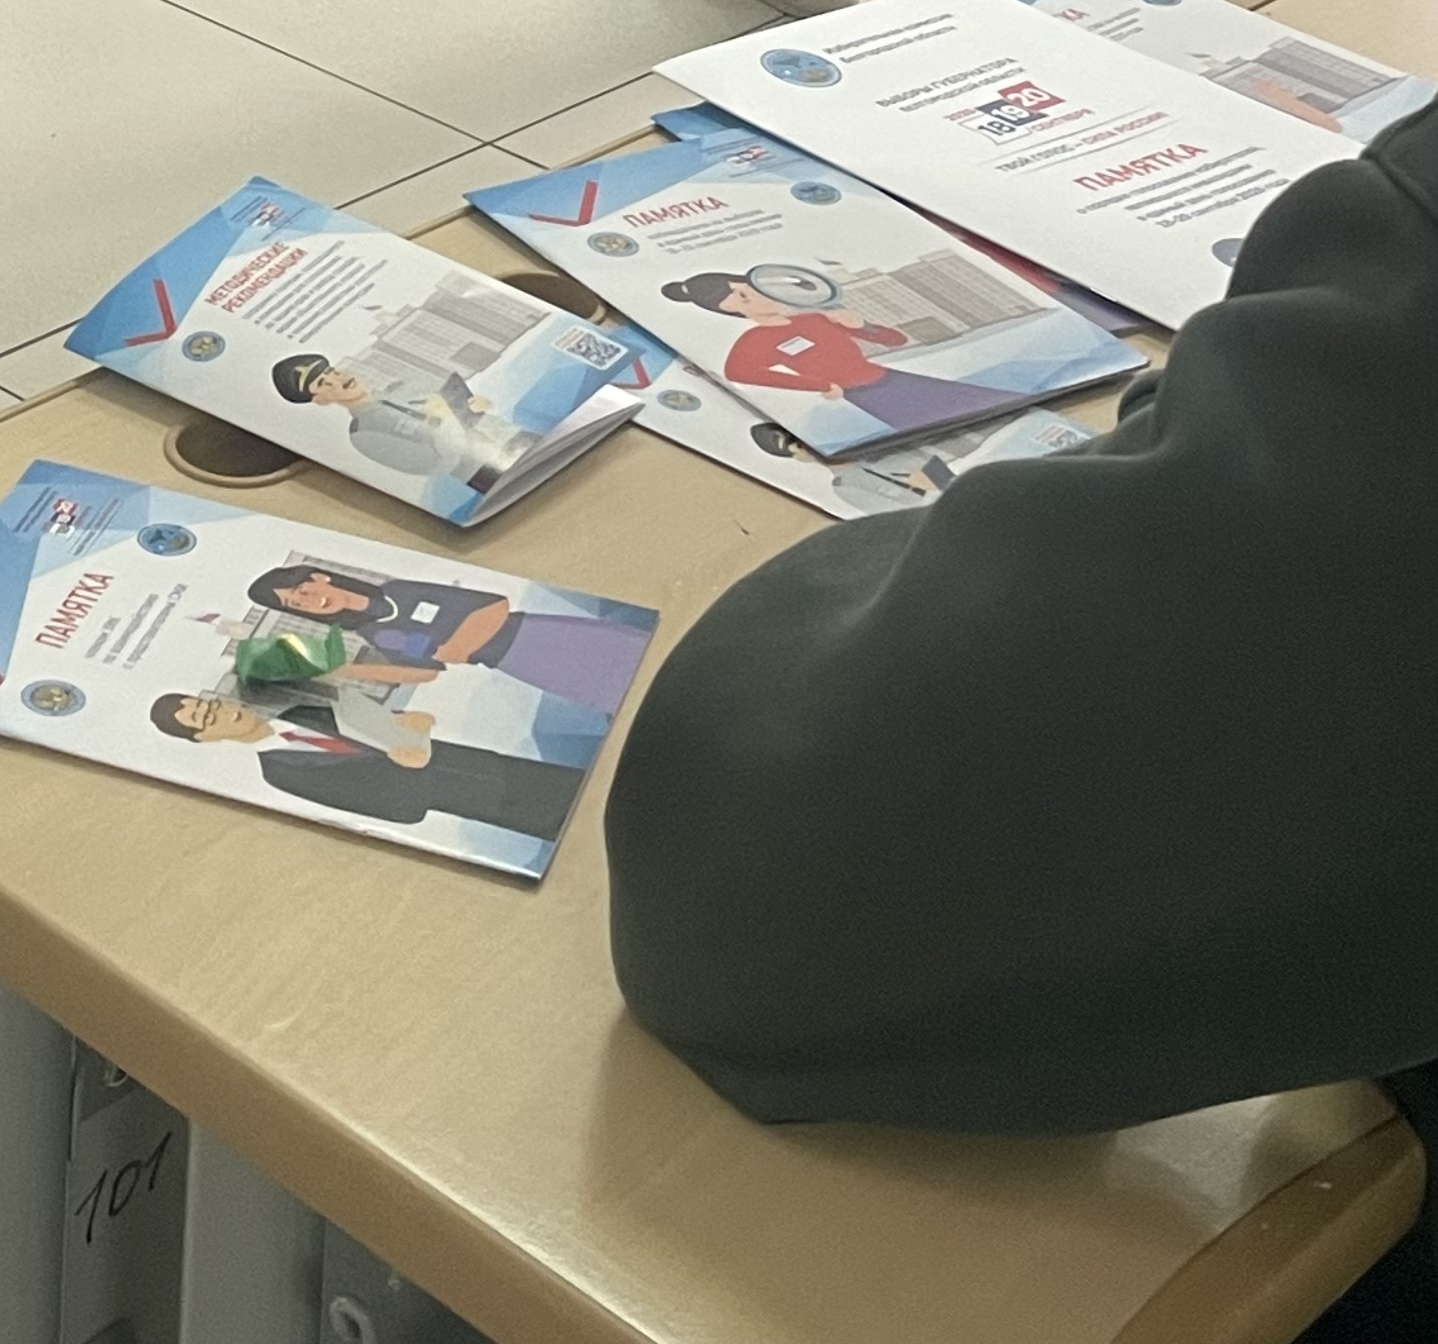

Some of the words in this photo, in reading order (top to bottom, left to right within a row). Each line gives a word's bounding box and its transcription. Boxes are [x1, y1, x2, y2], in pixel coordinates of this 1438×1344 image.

[991, 105, 1029, 121] 19
[1007, 88, 1050, 107] 20
[978, 121, 1016, 136] 18
[1074, 144, 1208, 191] ПАМЯТКА
[623, 196, 729, 228] ПАМЯТКА
[204, 241, 290, 306] МЕТОДИЧЕСКИЕ
[221, 248, 308, 313] РЕКОМЕНДАЦИИ
[35, 572, 114, 649] ПАМЯТКА
[74, 1131, 173, 1245] 101
